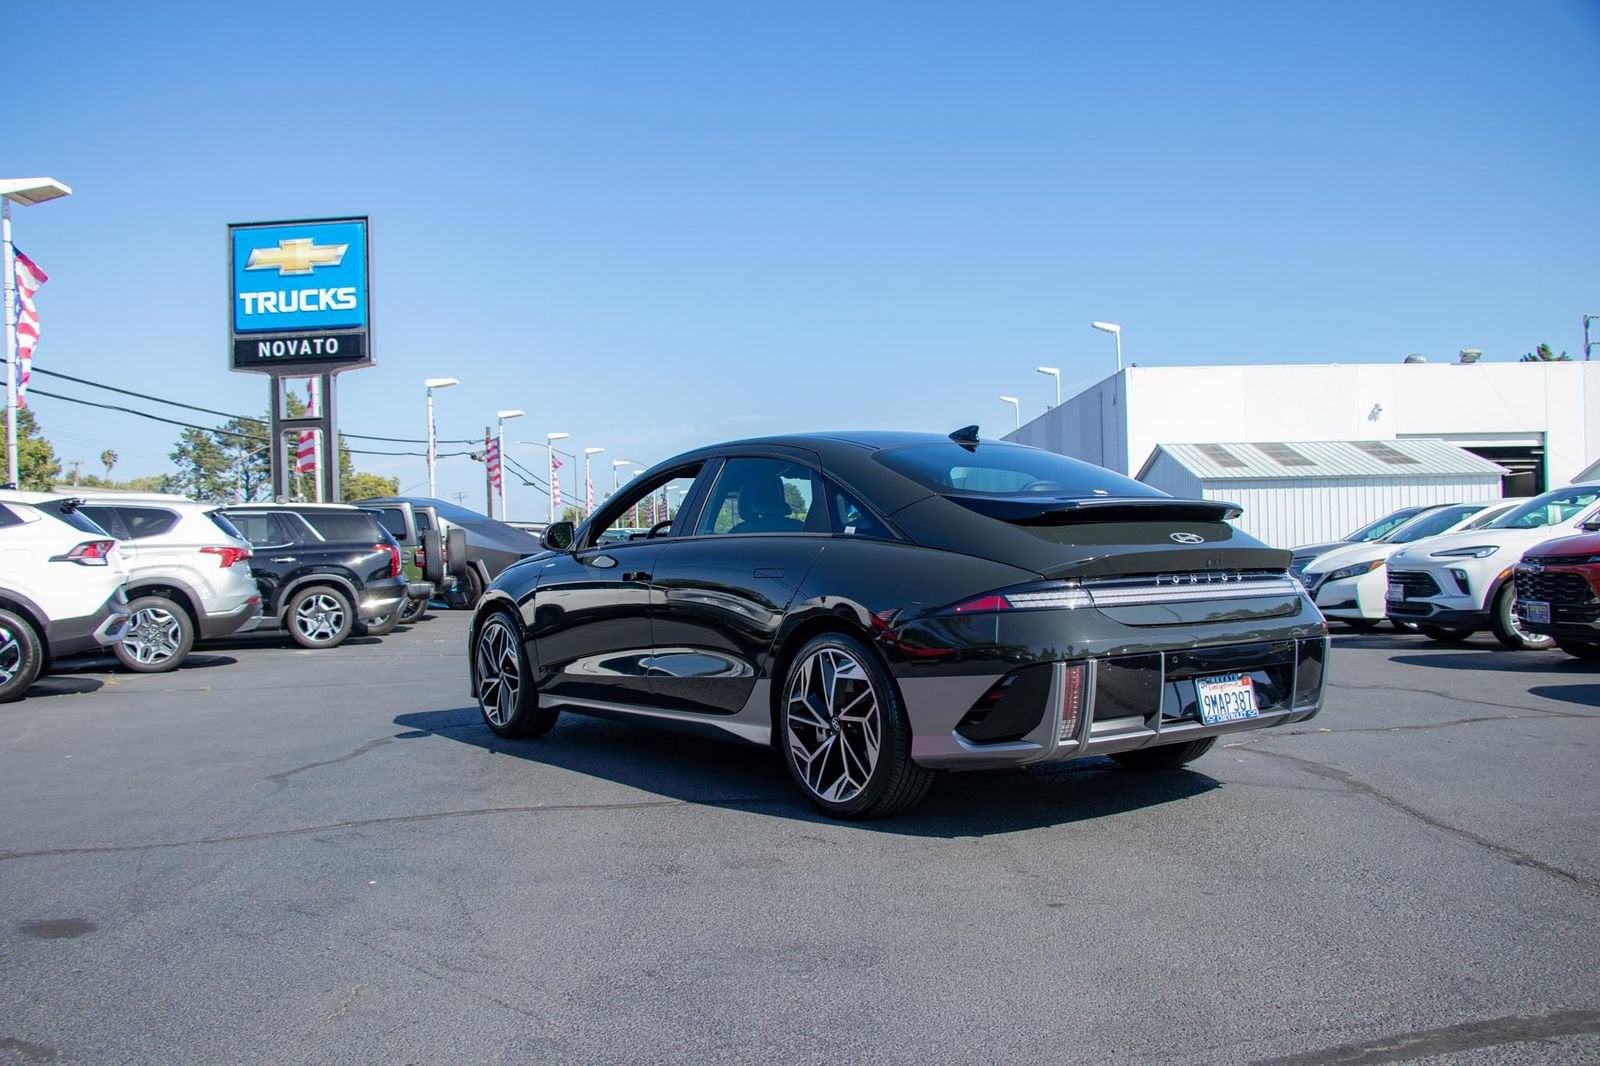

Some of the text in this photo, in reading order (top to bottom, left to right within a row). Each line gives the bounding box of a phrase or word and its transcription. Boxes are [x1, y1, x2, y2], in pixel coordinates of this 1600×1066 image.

[240, 287, 357, 315] TRUCKS
[258, 338, 339, 357] NOVATO
[1204, 690, 1252, 716] 9MAP387
